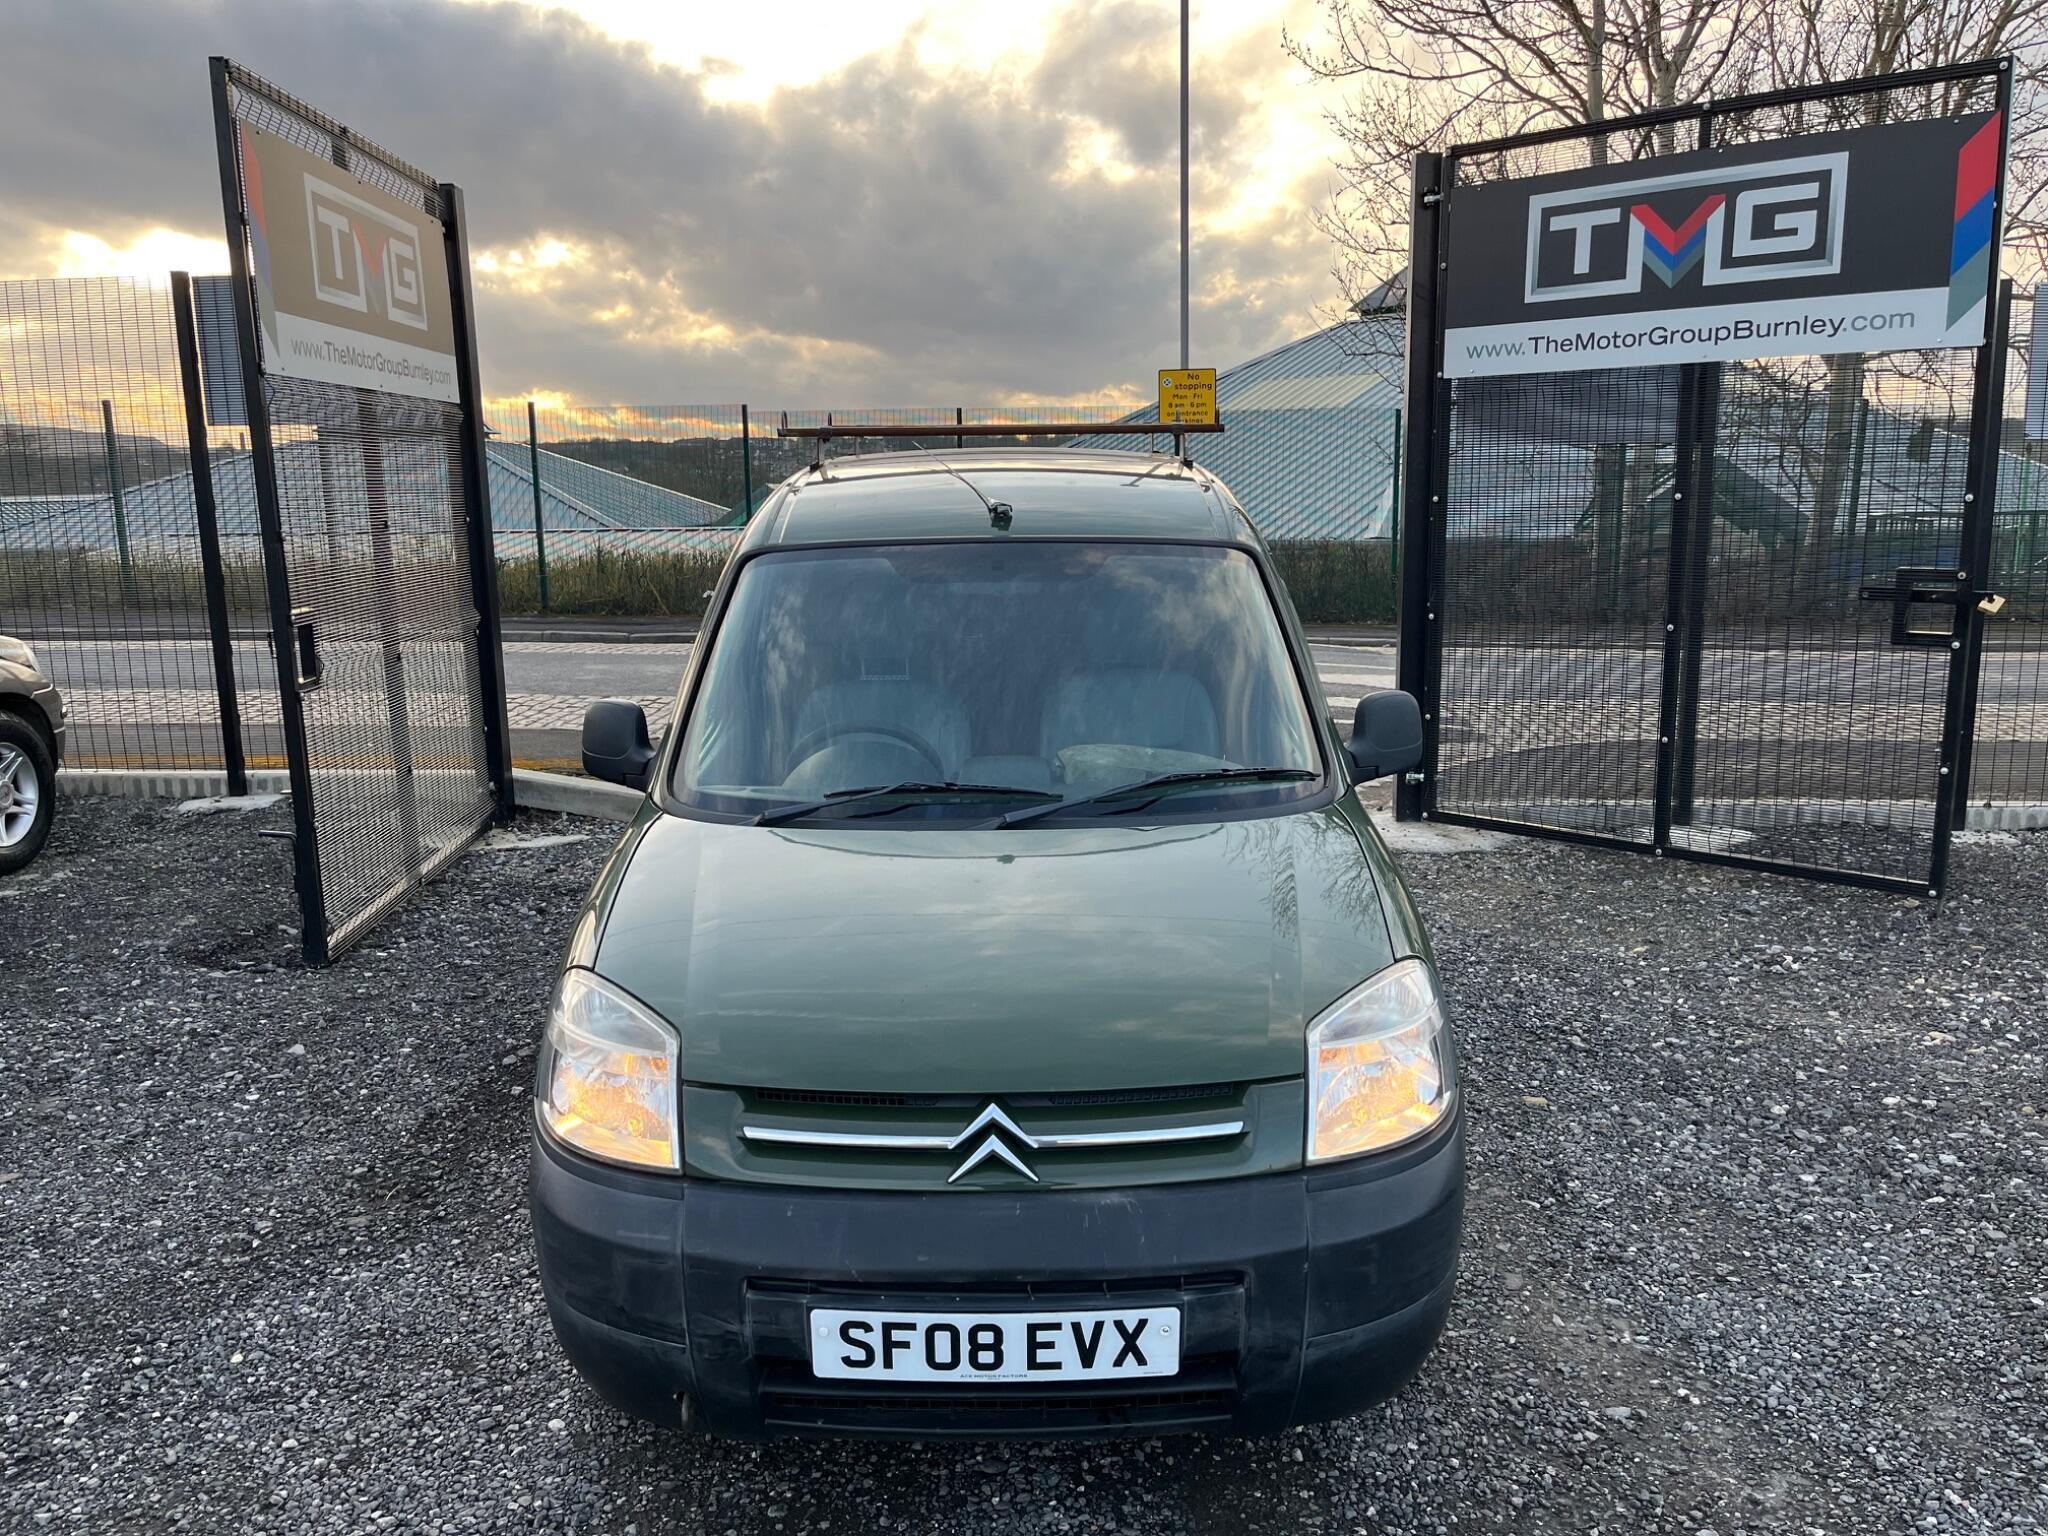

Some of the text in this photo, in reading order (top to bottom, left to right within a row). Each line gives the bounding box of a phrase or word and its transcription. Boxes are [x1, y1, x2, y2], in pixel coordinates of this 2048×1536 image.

[315, 204, 419, 319] TMG
[1548, 181, 1820, 292] TMG
[1466, 308, 1915, 360] www.TheMotorGroupBurnley.com
[289, 338, 452, 386] www.TheMotorGroupBurnley.com
[1175, 382, 1213, 391] stopping
[838, 1318, 1150, 1372] SF08 EVX
